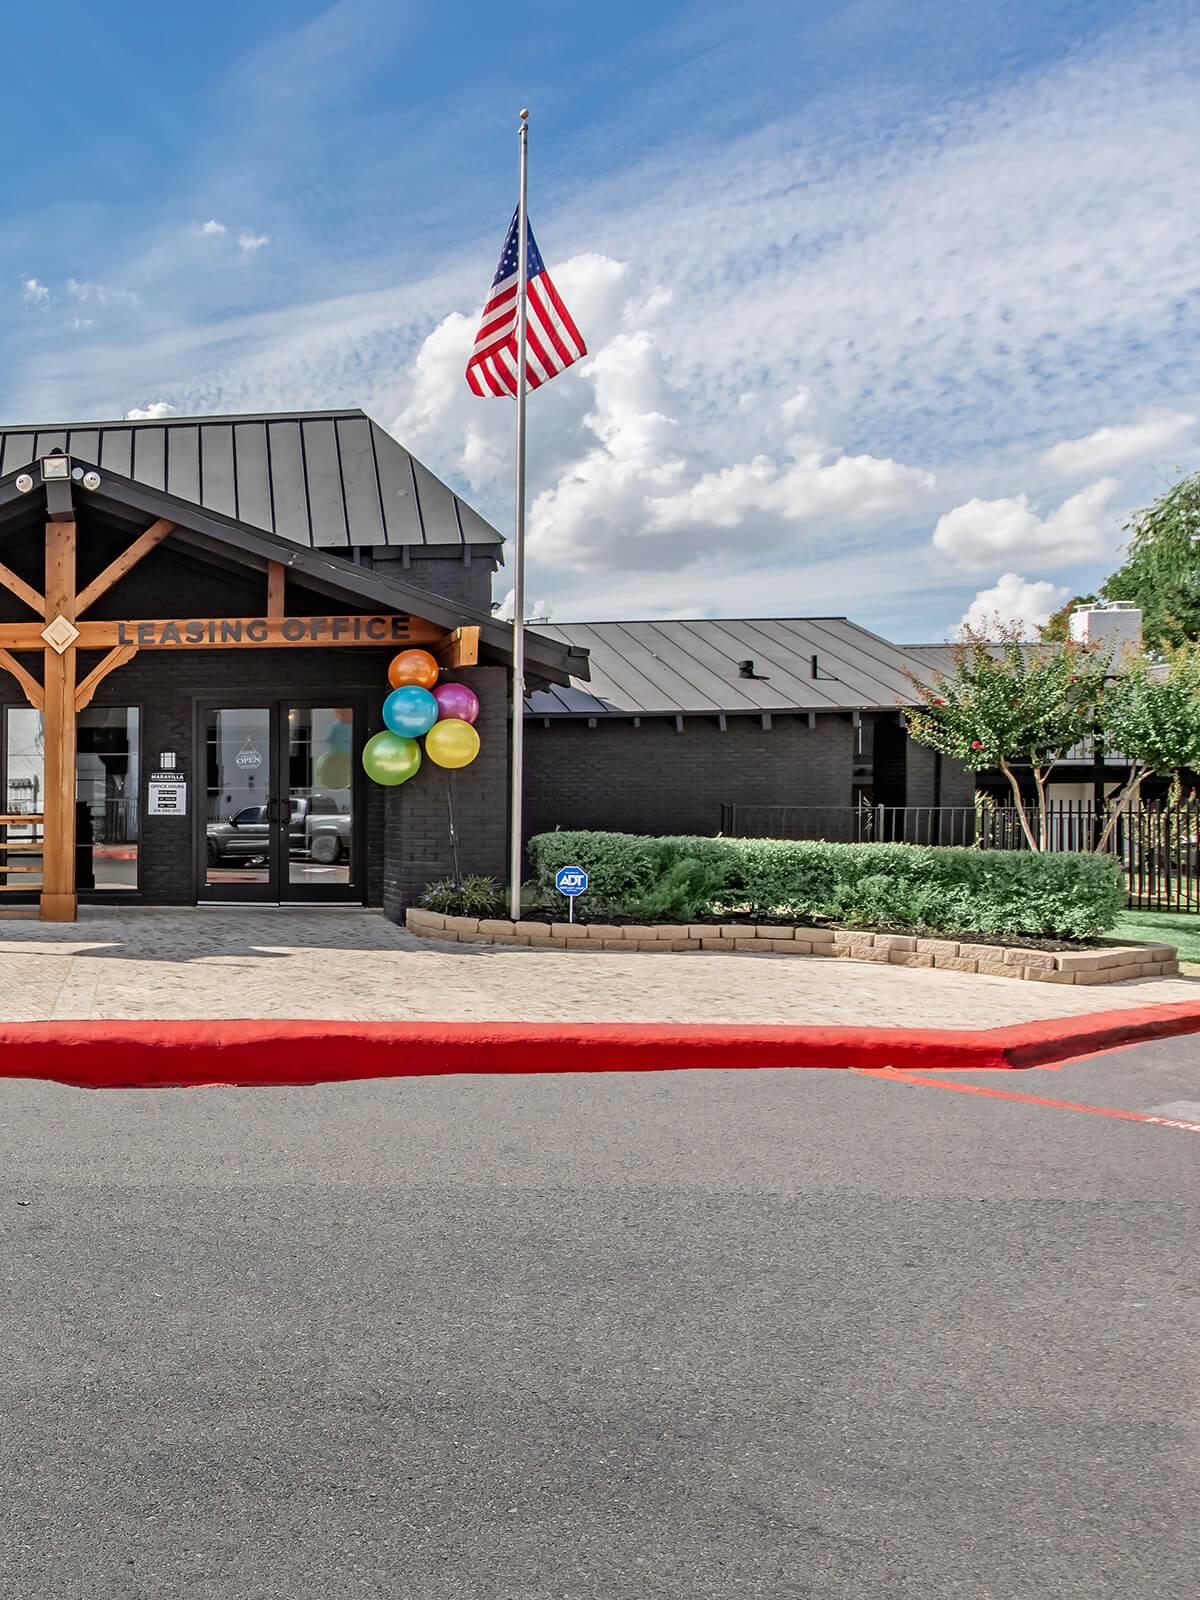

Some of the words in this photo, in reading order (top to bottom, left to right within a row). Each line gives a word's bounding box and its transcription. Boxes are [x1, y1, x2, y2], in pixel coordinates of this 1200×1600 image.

[118, 620, 268, 645] LEASING
[281, 617, 410, 642] OFFICE
[236, 756, 261, 764] OPEN
[559, 874, 584, 886] ADT
